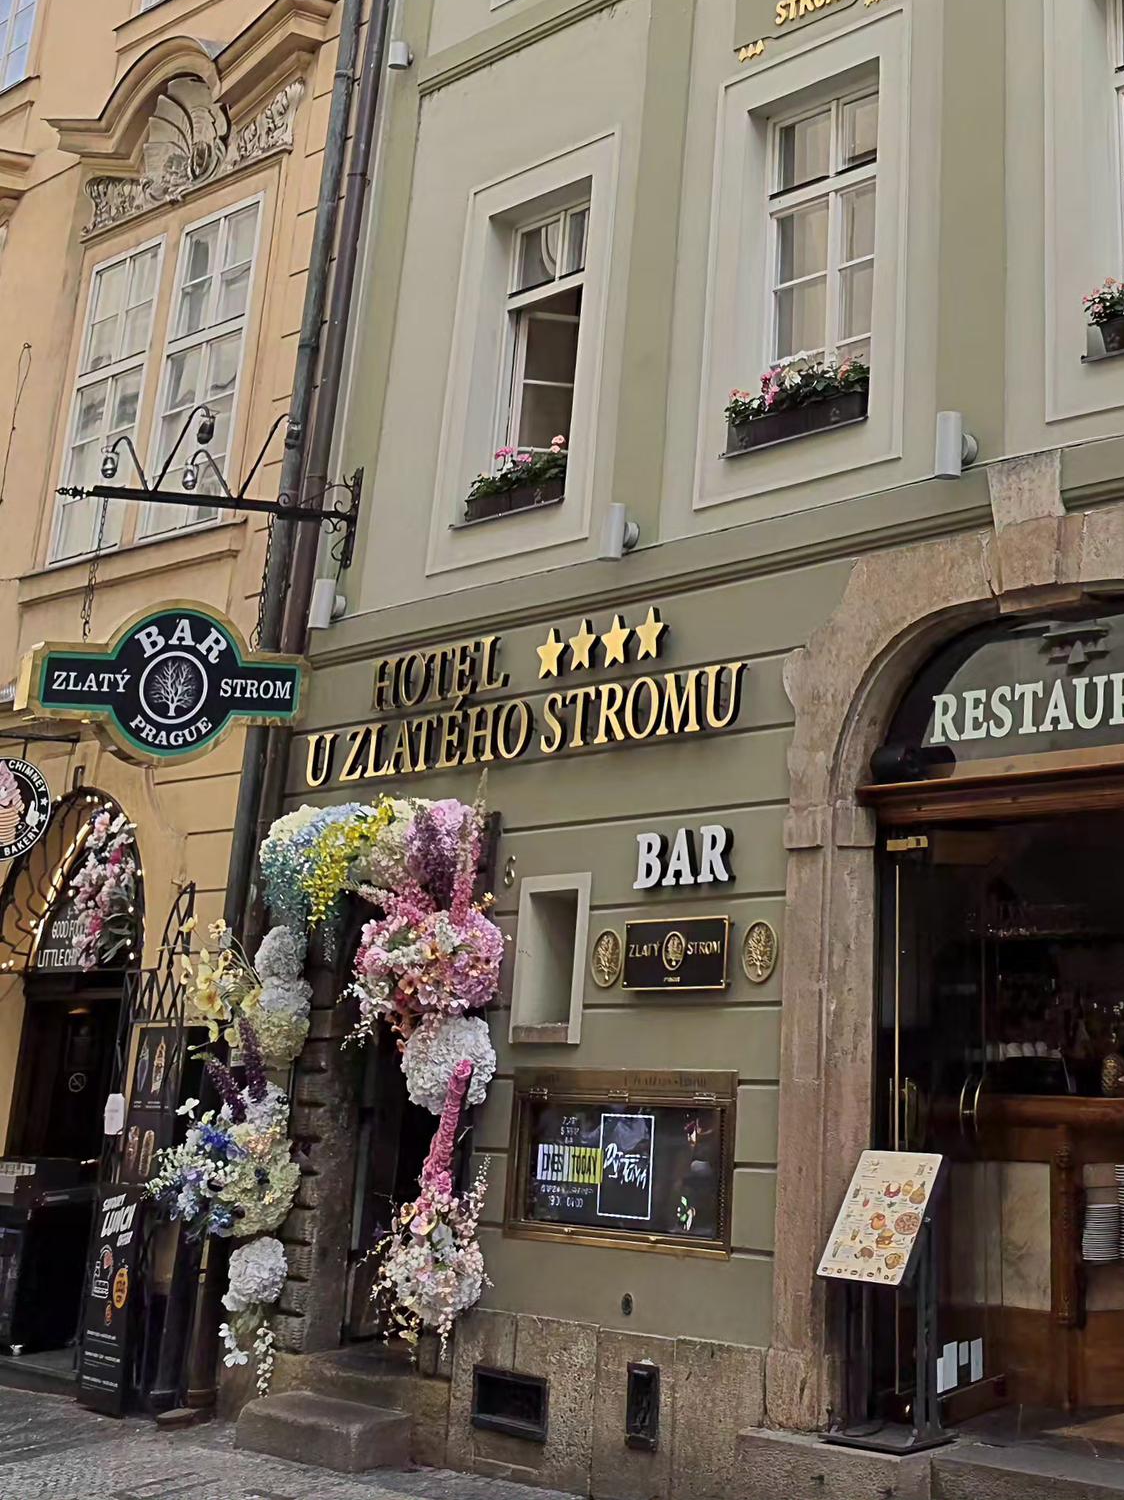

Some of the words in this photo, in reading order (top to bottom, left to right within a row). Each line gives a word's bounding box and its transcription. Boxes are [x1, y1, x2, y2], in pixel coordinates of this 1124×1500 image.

[134, 618, 230, 665] BAR
[52, 668, 131, 693] ZLATÝ
[219, 678, 292, 700] STROM
[371, 635, 508, 713] HOTEL
[129, 714, 213, 747] PRAGUE
[305, 732, 334, 788] U
[339, 695, 530, 783] ZLATÉHO
[540, 661, 744, 754] STROMU
[8, 759, 46, 793] CHIMNEY
[4, 825, 40, 856] BAKERY
[633, 824, 730, 890] BAR
[686, 940, 720, 955] STROM
